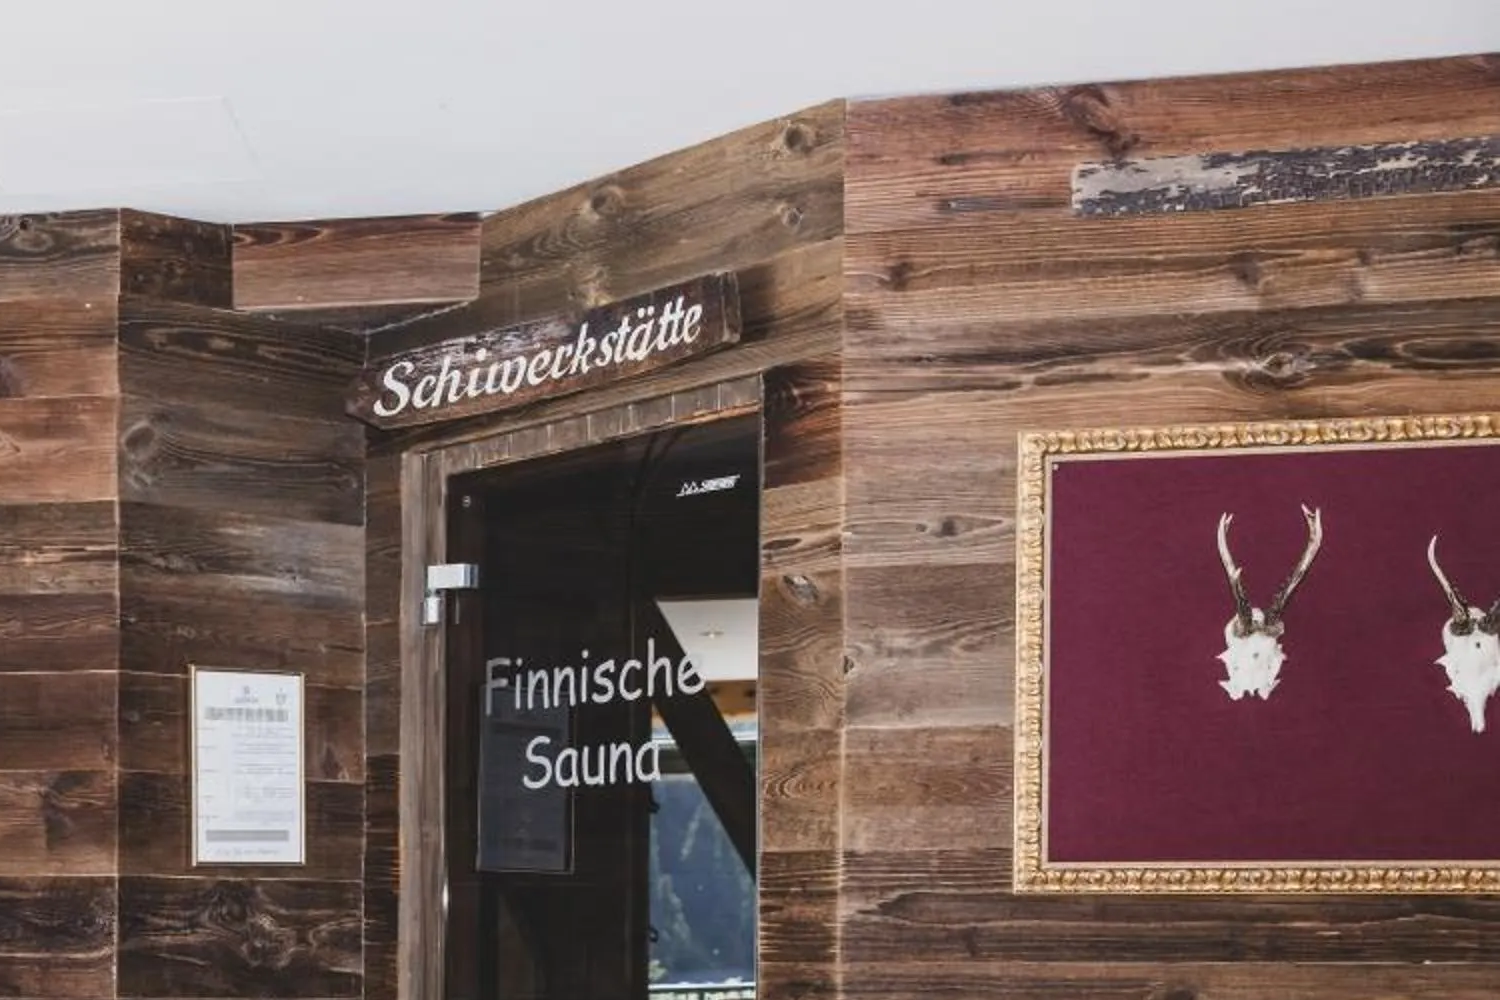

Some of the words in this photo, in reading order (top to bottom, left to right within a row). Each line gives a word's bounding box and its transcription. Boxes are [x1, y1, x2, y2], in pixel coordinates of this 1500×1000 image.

[372, 295, 703, 418] Schiwerkstätte
[485, 637, 708, 717] Finnische
[522, 734, 662, 791] Sauna
